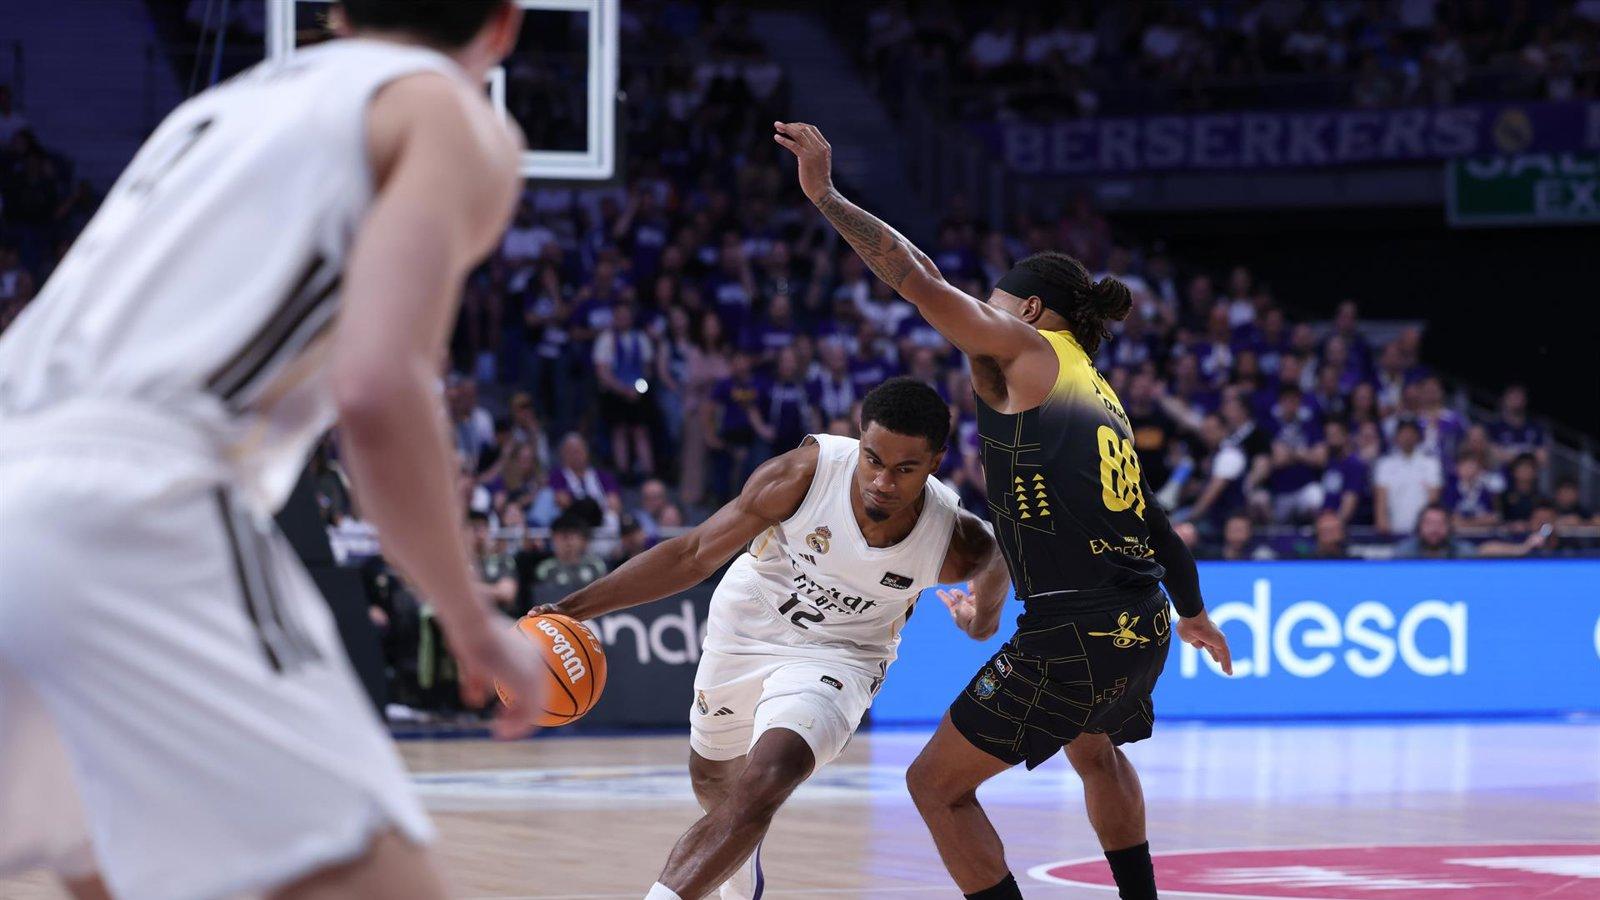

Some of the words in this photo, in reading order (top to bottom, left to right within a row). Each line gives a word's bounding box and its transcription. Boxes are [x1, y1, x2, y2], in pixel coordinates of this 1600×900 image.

[1004, 107, 1480, 174] BERSERKERS
[580, 599, 708, 666] nd
[778, 592, 826, 631] 12
[535, 619, 586, 685] Wilson
